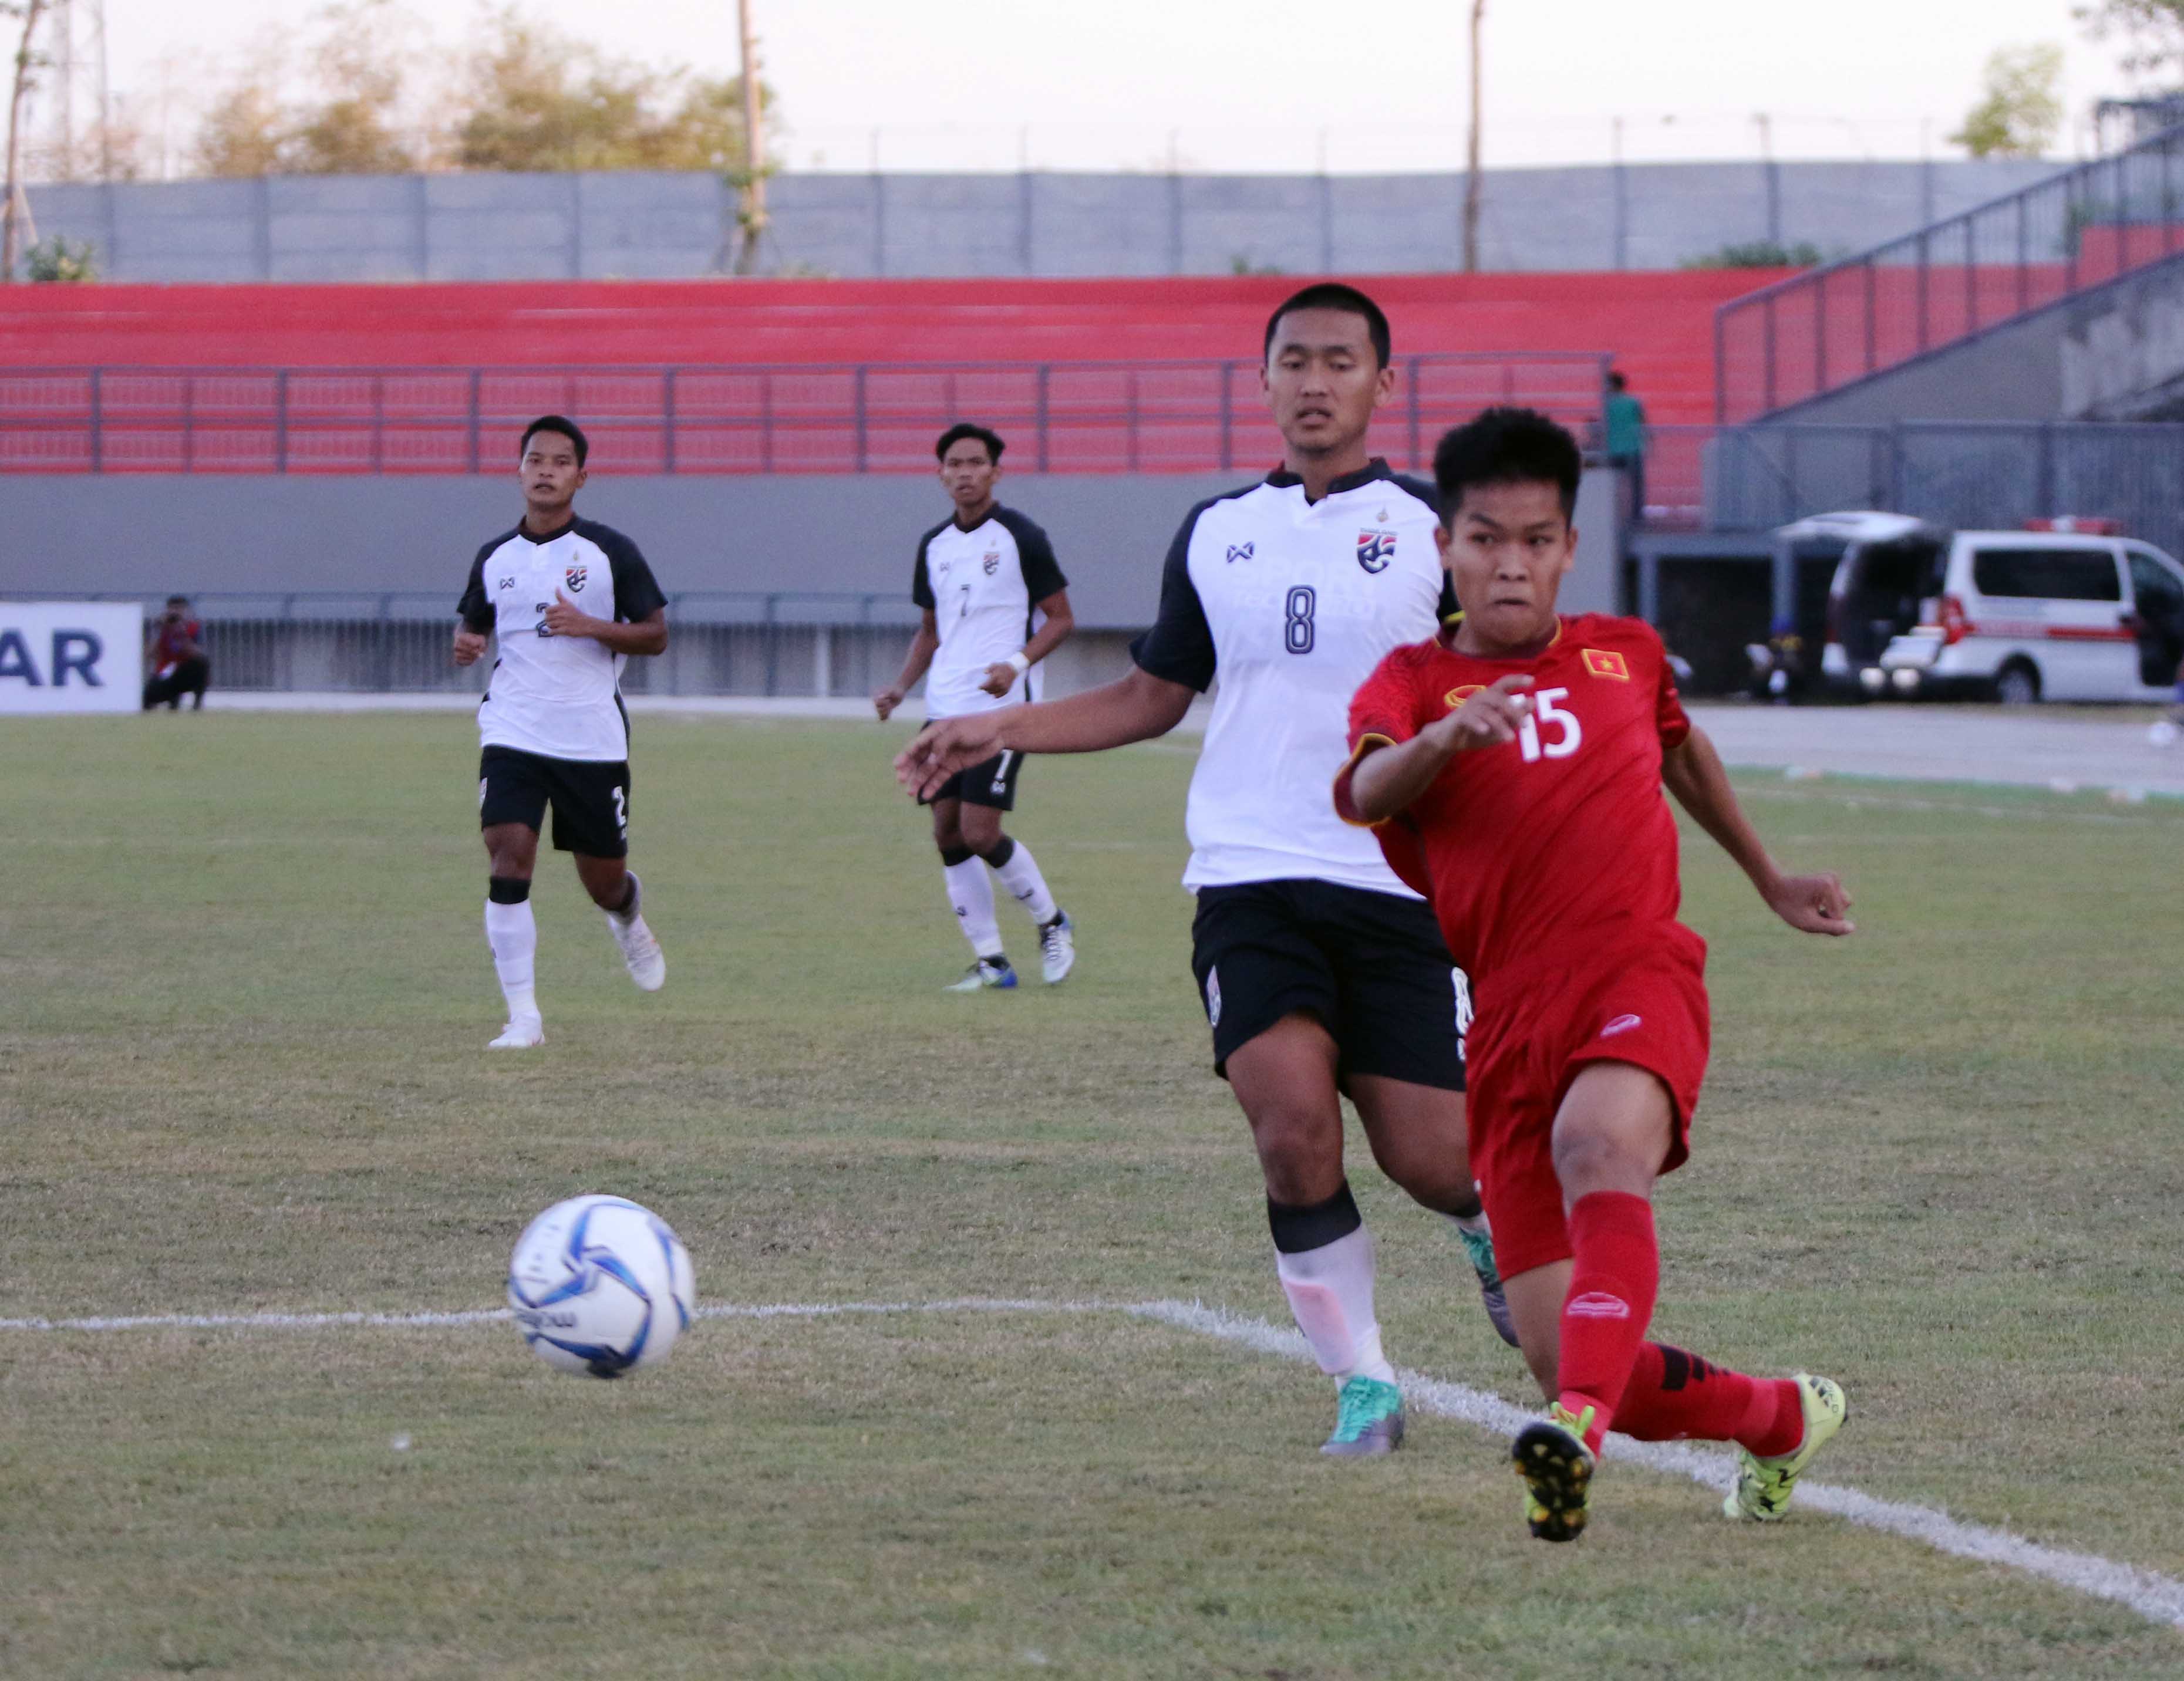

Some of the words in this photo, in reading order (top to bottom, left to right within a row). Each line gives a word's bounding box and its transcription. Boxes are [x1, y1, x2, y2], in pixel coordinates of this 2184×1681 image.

[961, 583, 970, 616] 7
[1285, 585, 1316, 654] 8
[1508, 687, 1582, 762] 15
[612, 786, 626, 826] 2
